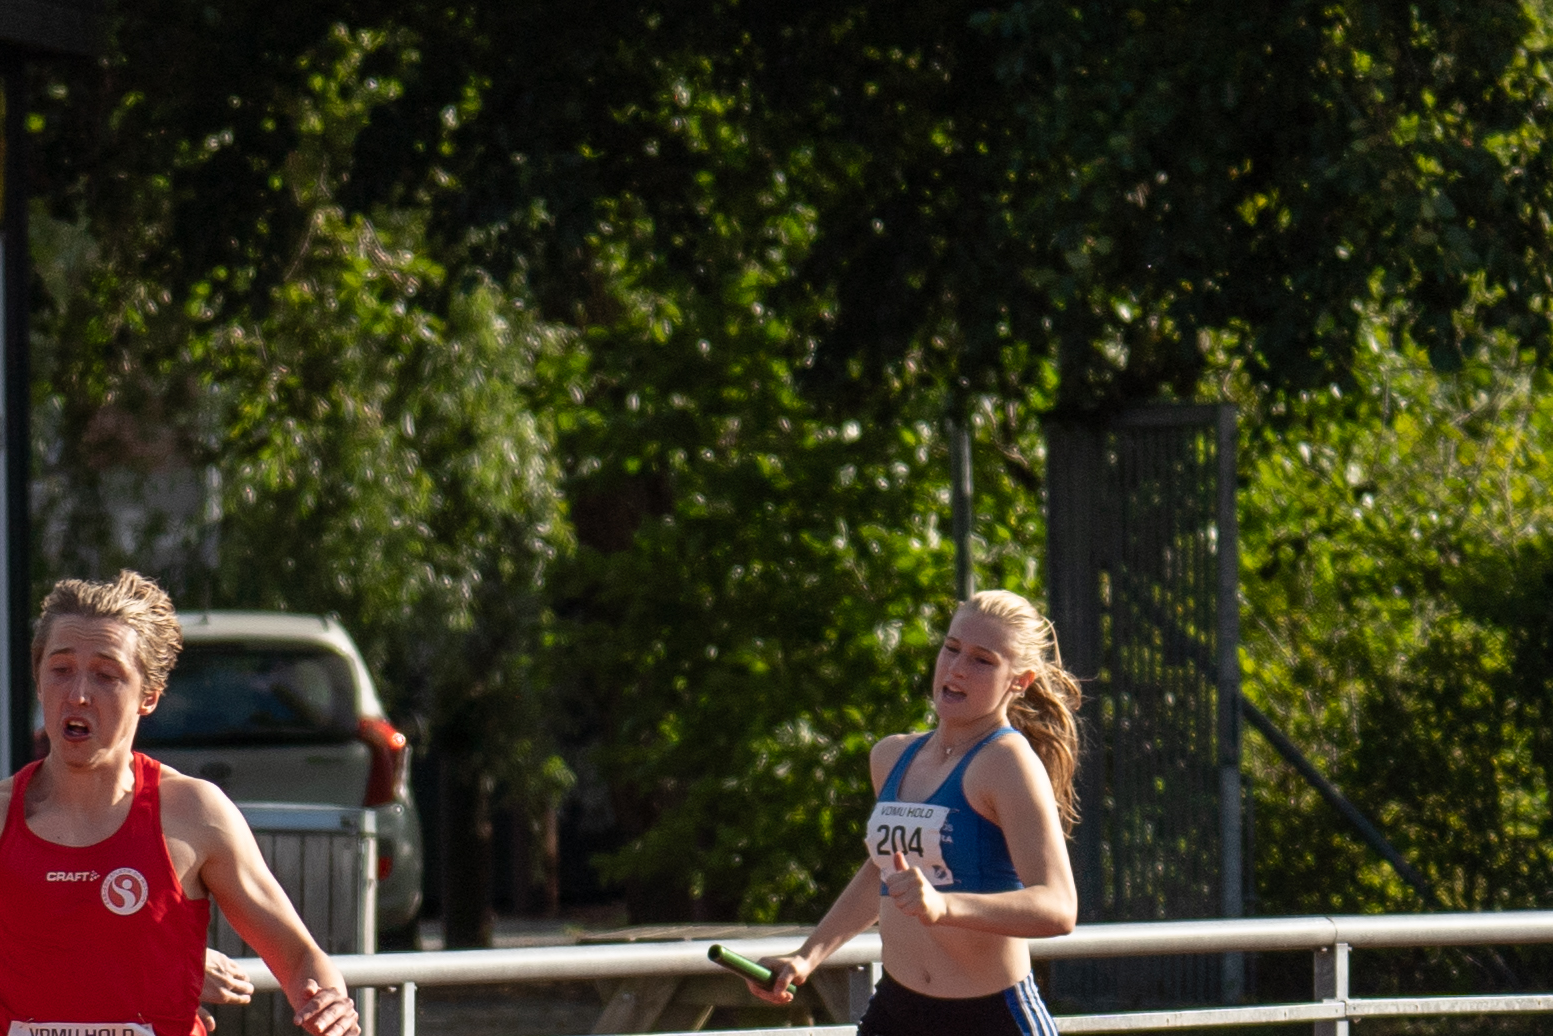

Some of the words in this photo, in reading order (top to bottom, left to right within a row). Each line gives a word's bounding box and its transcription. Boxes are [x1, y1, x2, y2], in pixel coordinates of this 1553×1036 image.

[880, 804, 906, 818] VDMU
[906, 806, 934, 819] HOLD
[876, 824, 924, 858] 204
[46, 871, 90, 882] CRAFT
